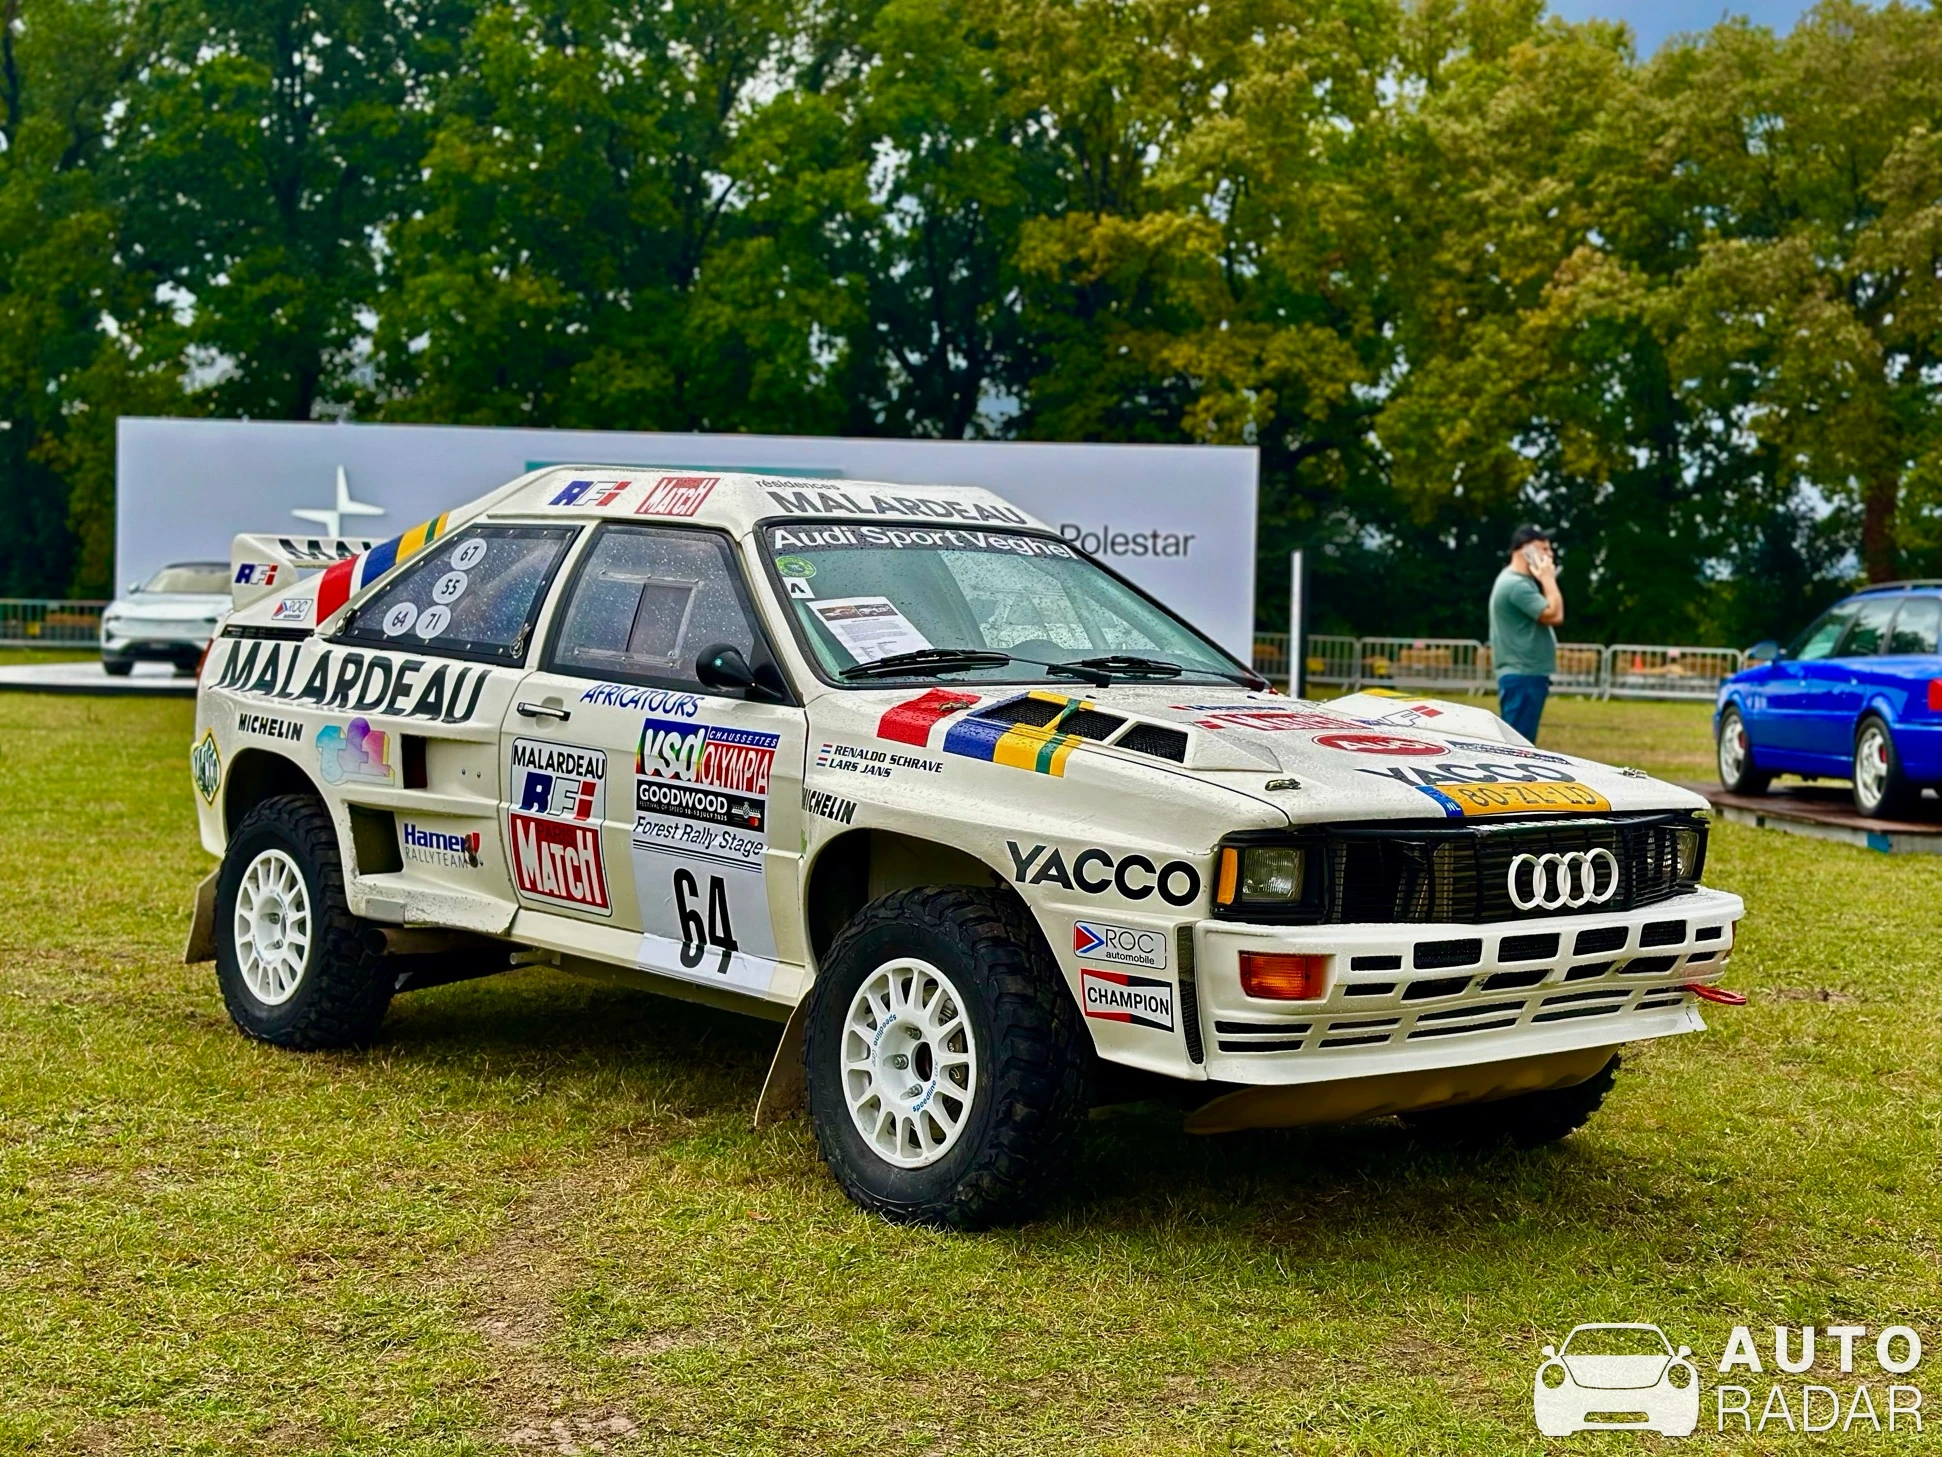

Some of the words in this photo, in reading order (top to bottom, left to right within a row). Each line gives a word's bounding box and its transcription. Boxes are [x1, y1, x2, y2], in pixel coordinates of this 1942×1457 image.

[638, 479, 715, 514] MATCH
[755, 480, 841, 491] résidences
[766, 491, 1027, 525] MALARDEAU
[460, 546, 480, 562] 67
[775, 526, 858, 549] Audi
[864, 525, 961, 549] Sport
[963, 531, 1079, 559] Veghel
[1060, 523, 1196, 557] Polestar
[441, 579, 460, 595] 55
[392, 611, 409, 627] 64
[425, 613, 441, 630] 71
[208, 640, 492, 723] MALARDEAU
[580, 684, 704, 717] AFRICATOURS
[238, 713, 304, 742] MICHELIN
[709, 730, 777, 748] CHAUSSETTES
[513, 745, 605, 780] MALARDEAU
[702, 744, 770, 795] OLYMPIA
[829, 758, 859, 772] LARS
[860, 764, 892, 778] JANS
[834, 745, 886, 762] RENALDO
[889, 754, 943, 773] SCHRAVE
[1354, 763, 1576, 787] YACCO
[639, 784, 728, 814] GOODWOOD
[639, 801, 660, 810] FESTIVAL
[700, 810, 713, 819] JULY
[1446, 803, 1461, 811] NL
[633, 816, 679, 839] Forest
[680, 823, 718, 850] Rally
[719, 831, 763, 858] Stage
[516, 819, 603, 904] MATCH
[1005, 840, 1201, 907] YACCO
[673, 867, 739, 975] 64
[1105, 929, 1154, 954] ROC
[1106, 951, 1155, 965] automobile
[1087, 986, 1170, 1016] CHAMPION
[873, 1013, 897, 1046] speedline
[912, 1080, 937, 1112] speedline
